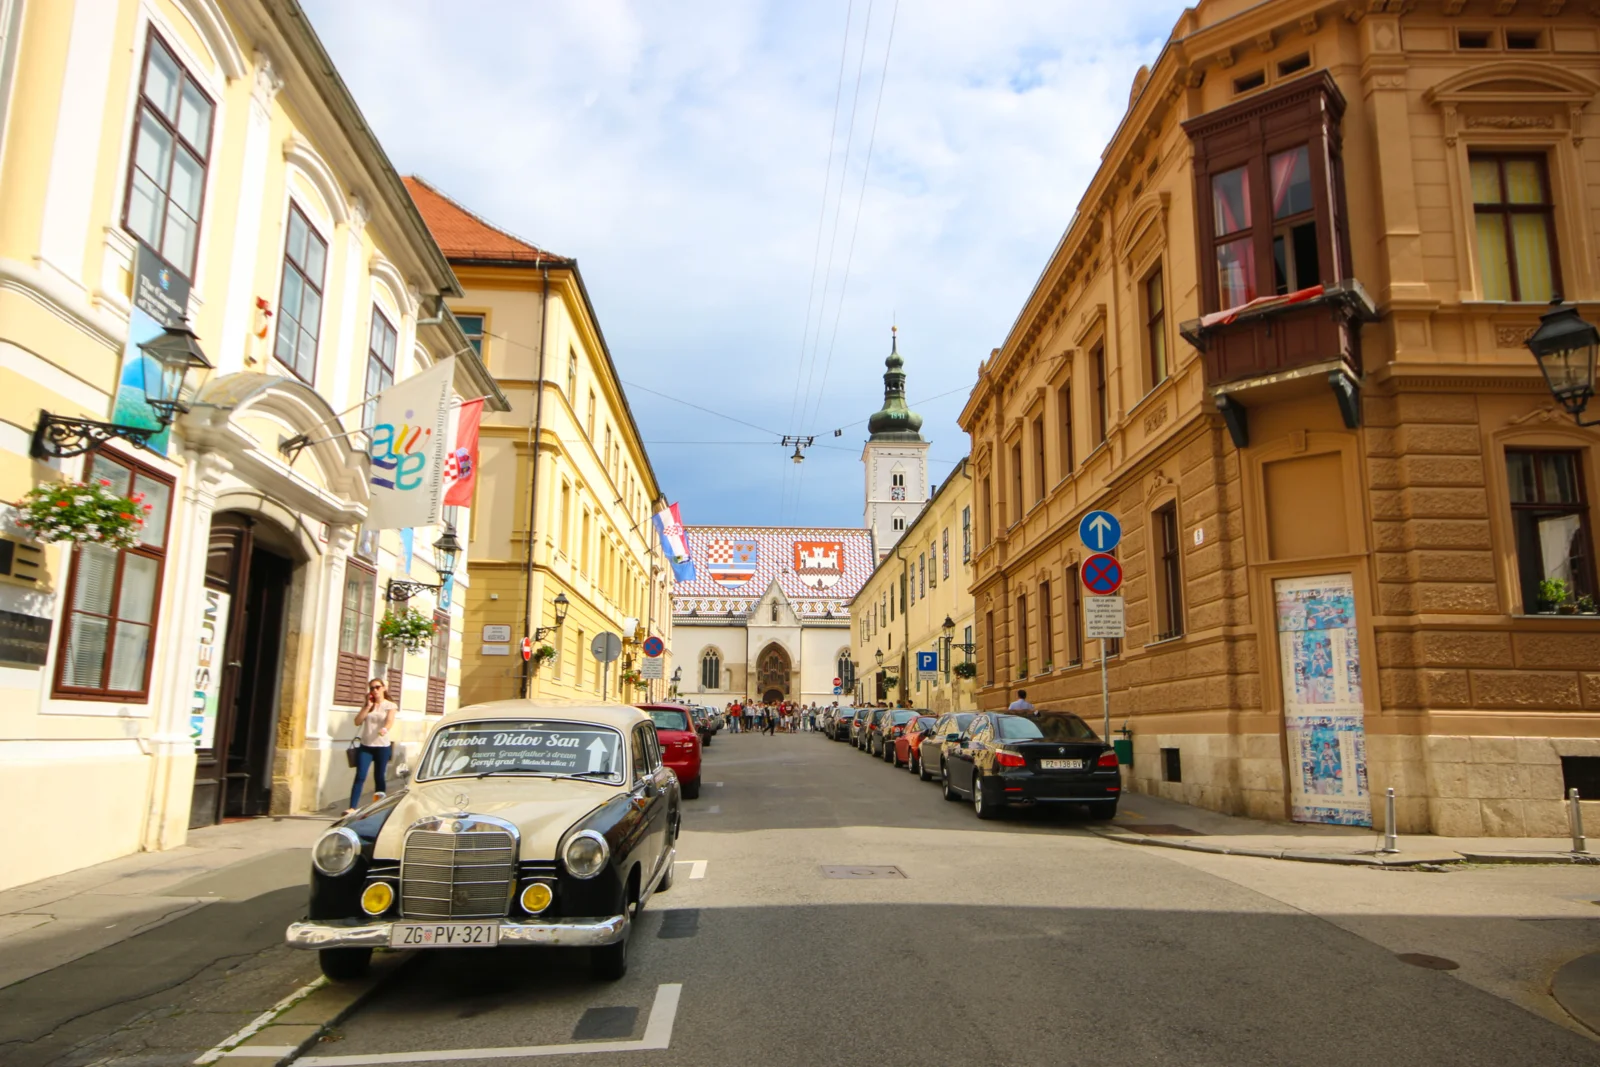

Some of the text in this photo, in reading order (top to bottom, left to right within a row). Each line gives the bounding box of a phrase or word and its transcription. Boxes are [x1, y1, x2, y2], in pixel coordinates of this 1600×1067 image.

[189, 590, 220, 747] MUSEUM
[923, 655, 932, 668] P
[493, 732, 543, 746] Didov
[545, 733, 580, 748] San
[551, 751, 577, 759] dream
[470, 758, 494, 768] Gornji
[494, 758, 516, 766] grad
[404, 926, 423, 944] ZG
